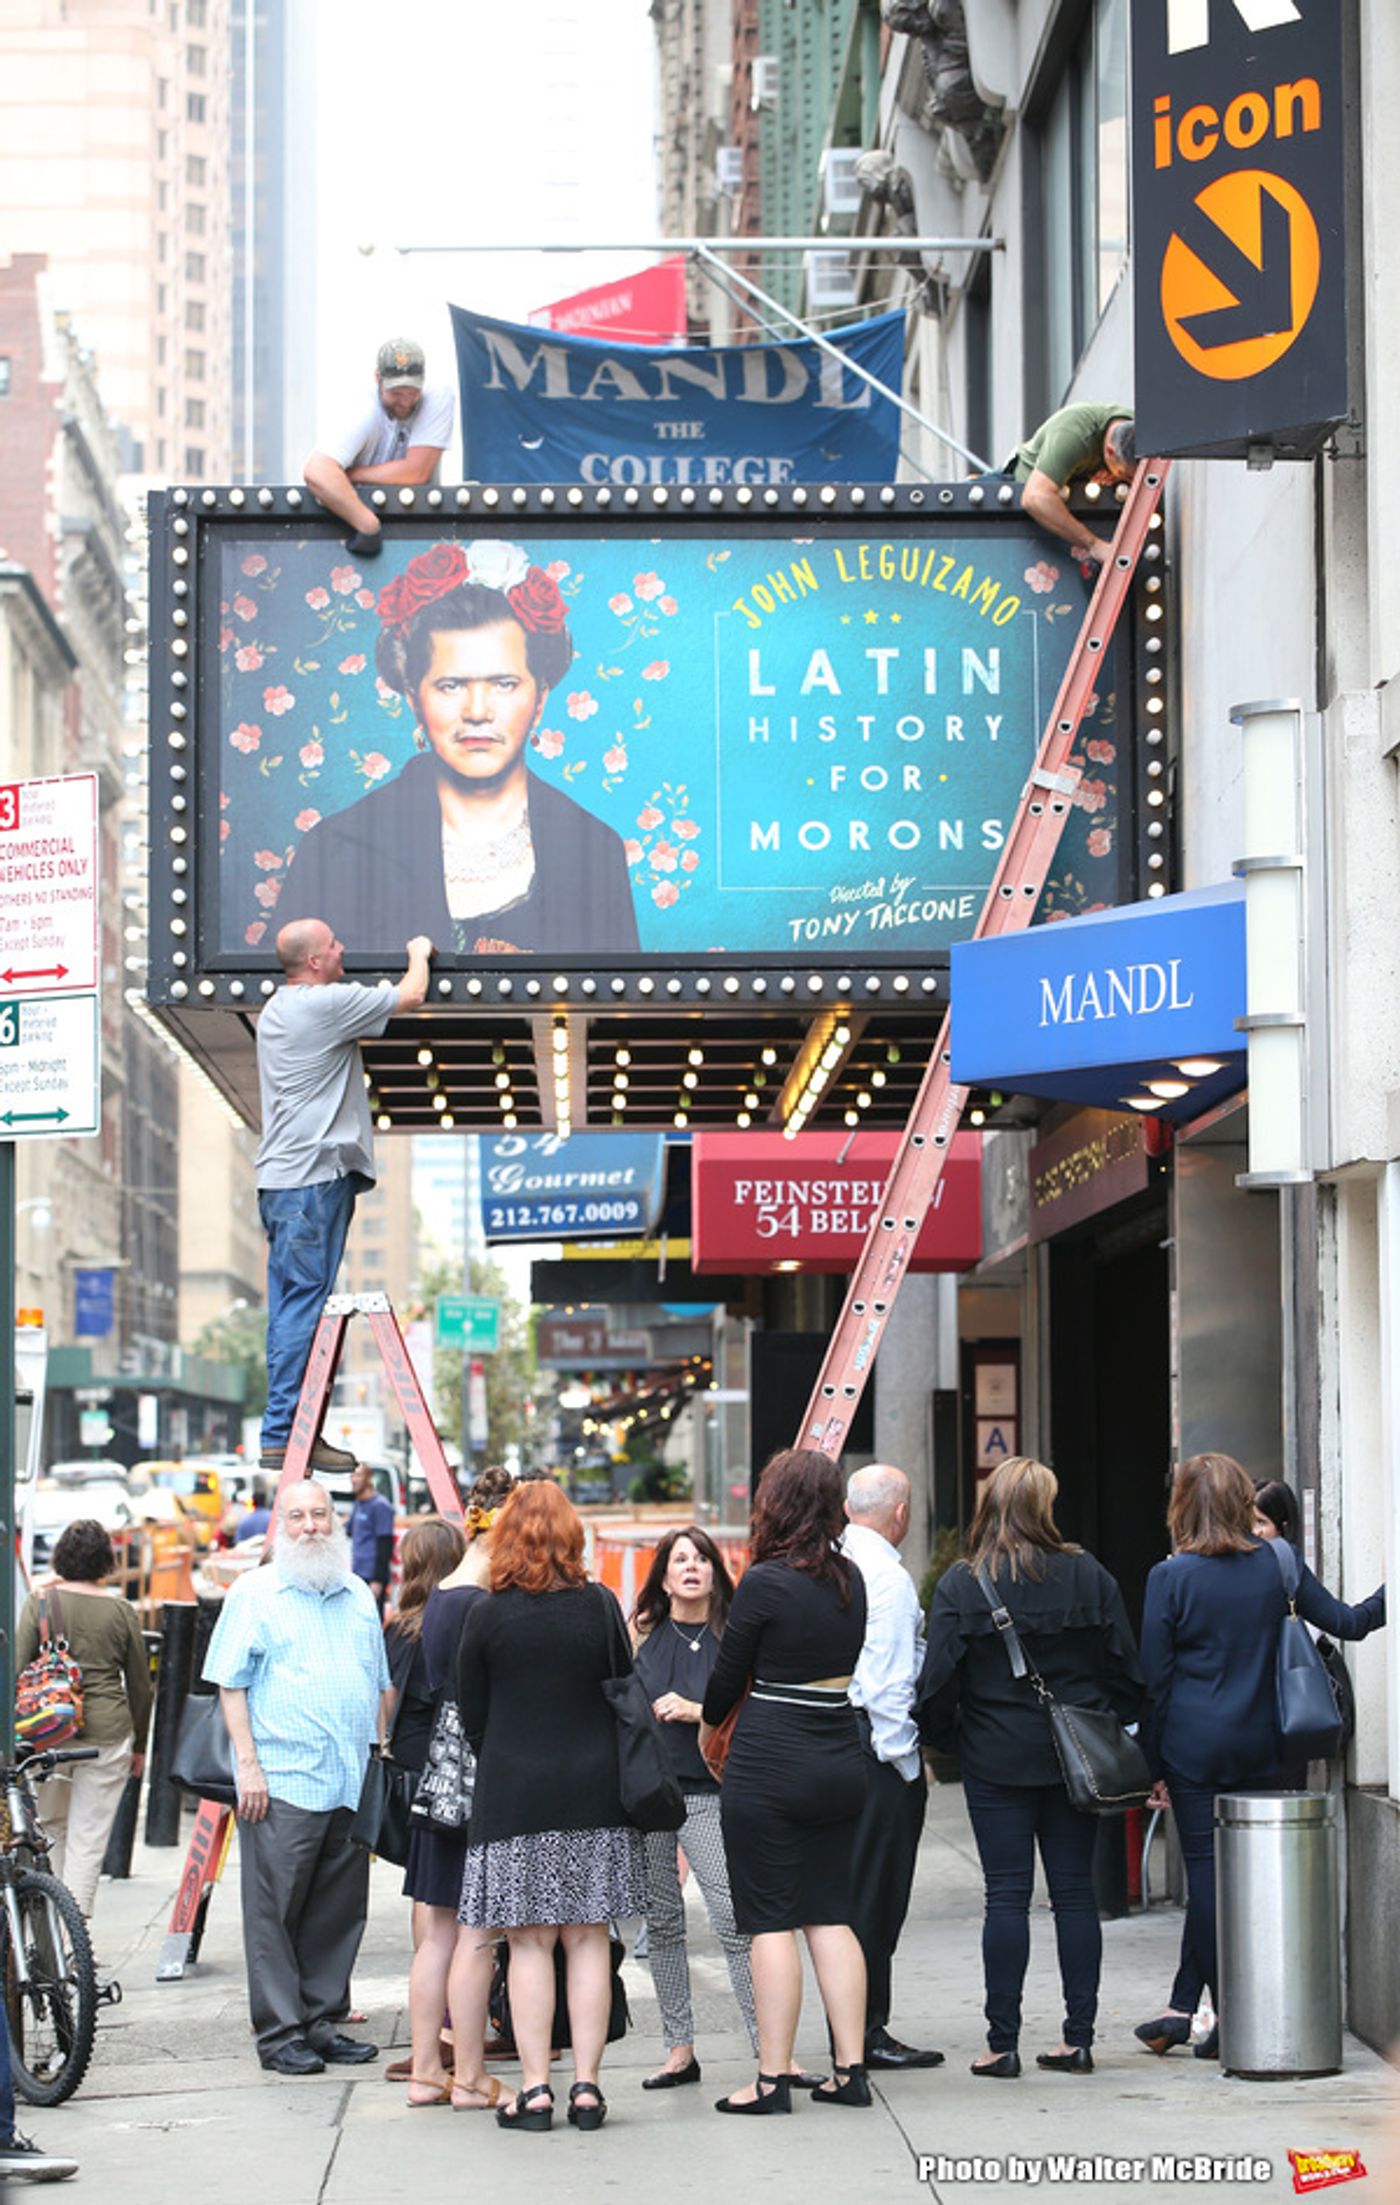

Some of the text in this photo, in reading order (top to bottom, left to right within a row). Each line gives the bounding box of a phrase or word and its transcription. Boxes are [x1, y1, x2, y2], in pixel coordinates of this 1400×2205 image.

[1154, 77, 1322, 169] icon
[476, 327, 872, 410] MANDL
[654, 421, 705, 439] THE
[579, 453, 796, 486] COLLEGE
[731, 544, 1021, 630] JOHN LEGUIZAMO
[749, 647, 1001, 697] LATIN
[749, 715, 1003, 743] HISTORY
[830, 764, 923, 791] FOR
[0, 789, 16, 830] 3
[750, 819, 1005, 851] MORONS
[58, 858, 88, 879] ONLY
[828, 872, 916, 905] Directed by
[788, 894, 976, 943] TONY TACCONE
[1038, 959, 1195, 1028] MANDL
[0, 1006, 16, 1046] 6
[487, 1163, 636, 1194] Gourmet
[734, 1180, 888, 1205] FEINSTEI
[490, 1201, 639, 1228] 212.767.0009
[756, 1204, 878, 1238] 54 BEL
[984, 1426, 1009, 1455] A
